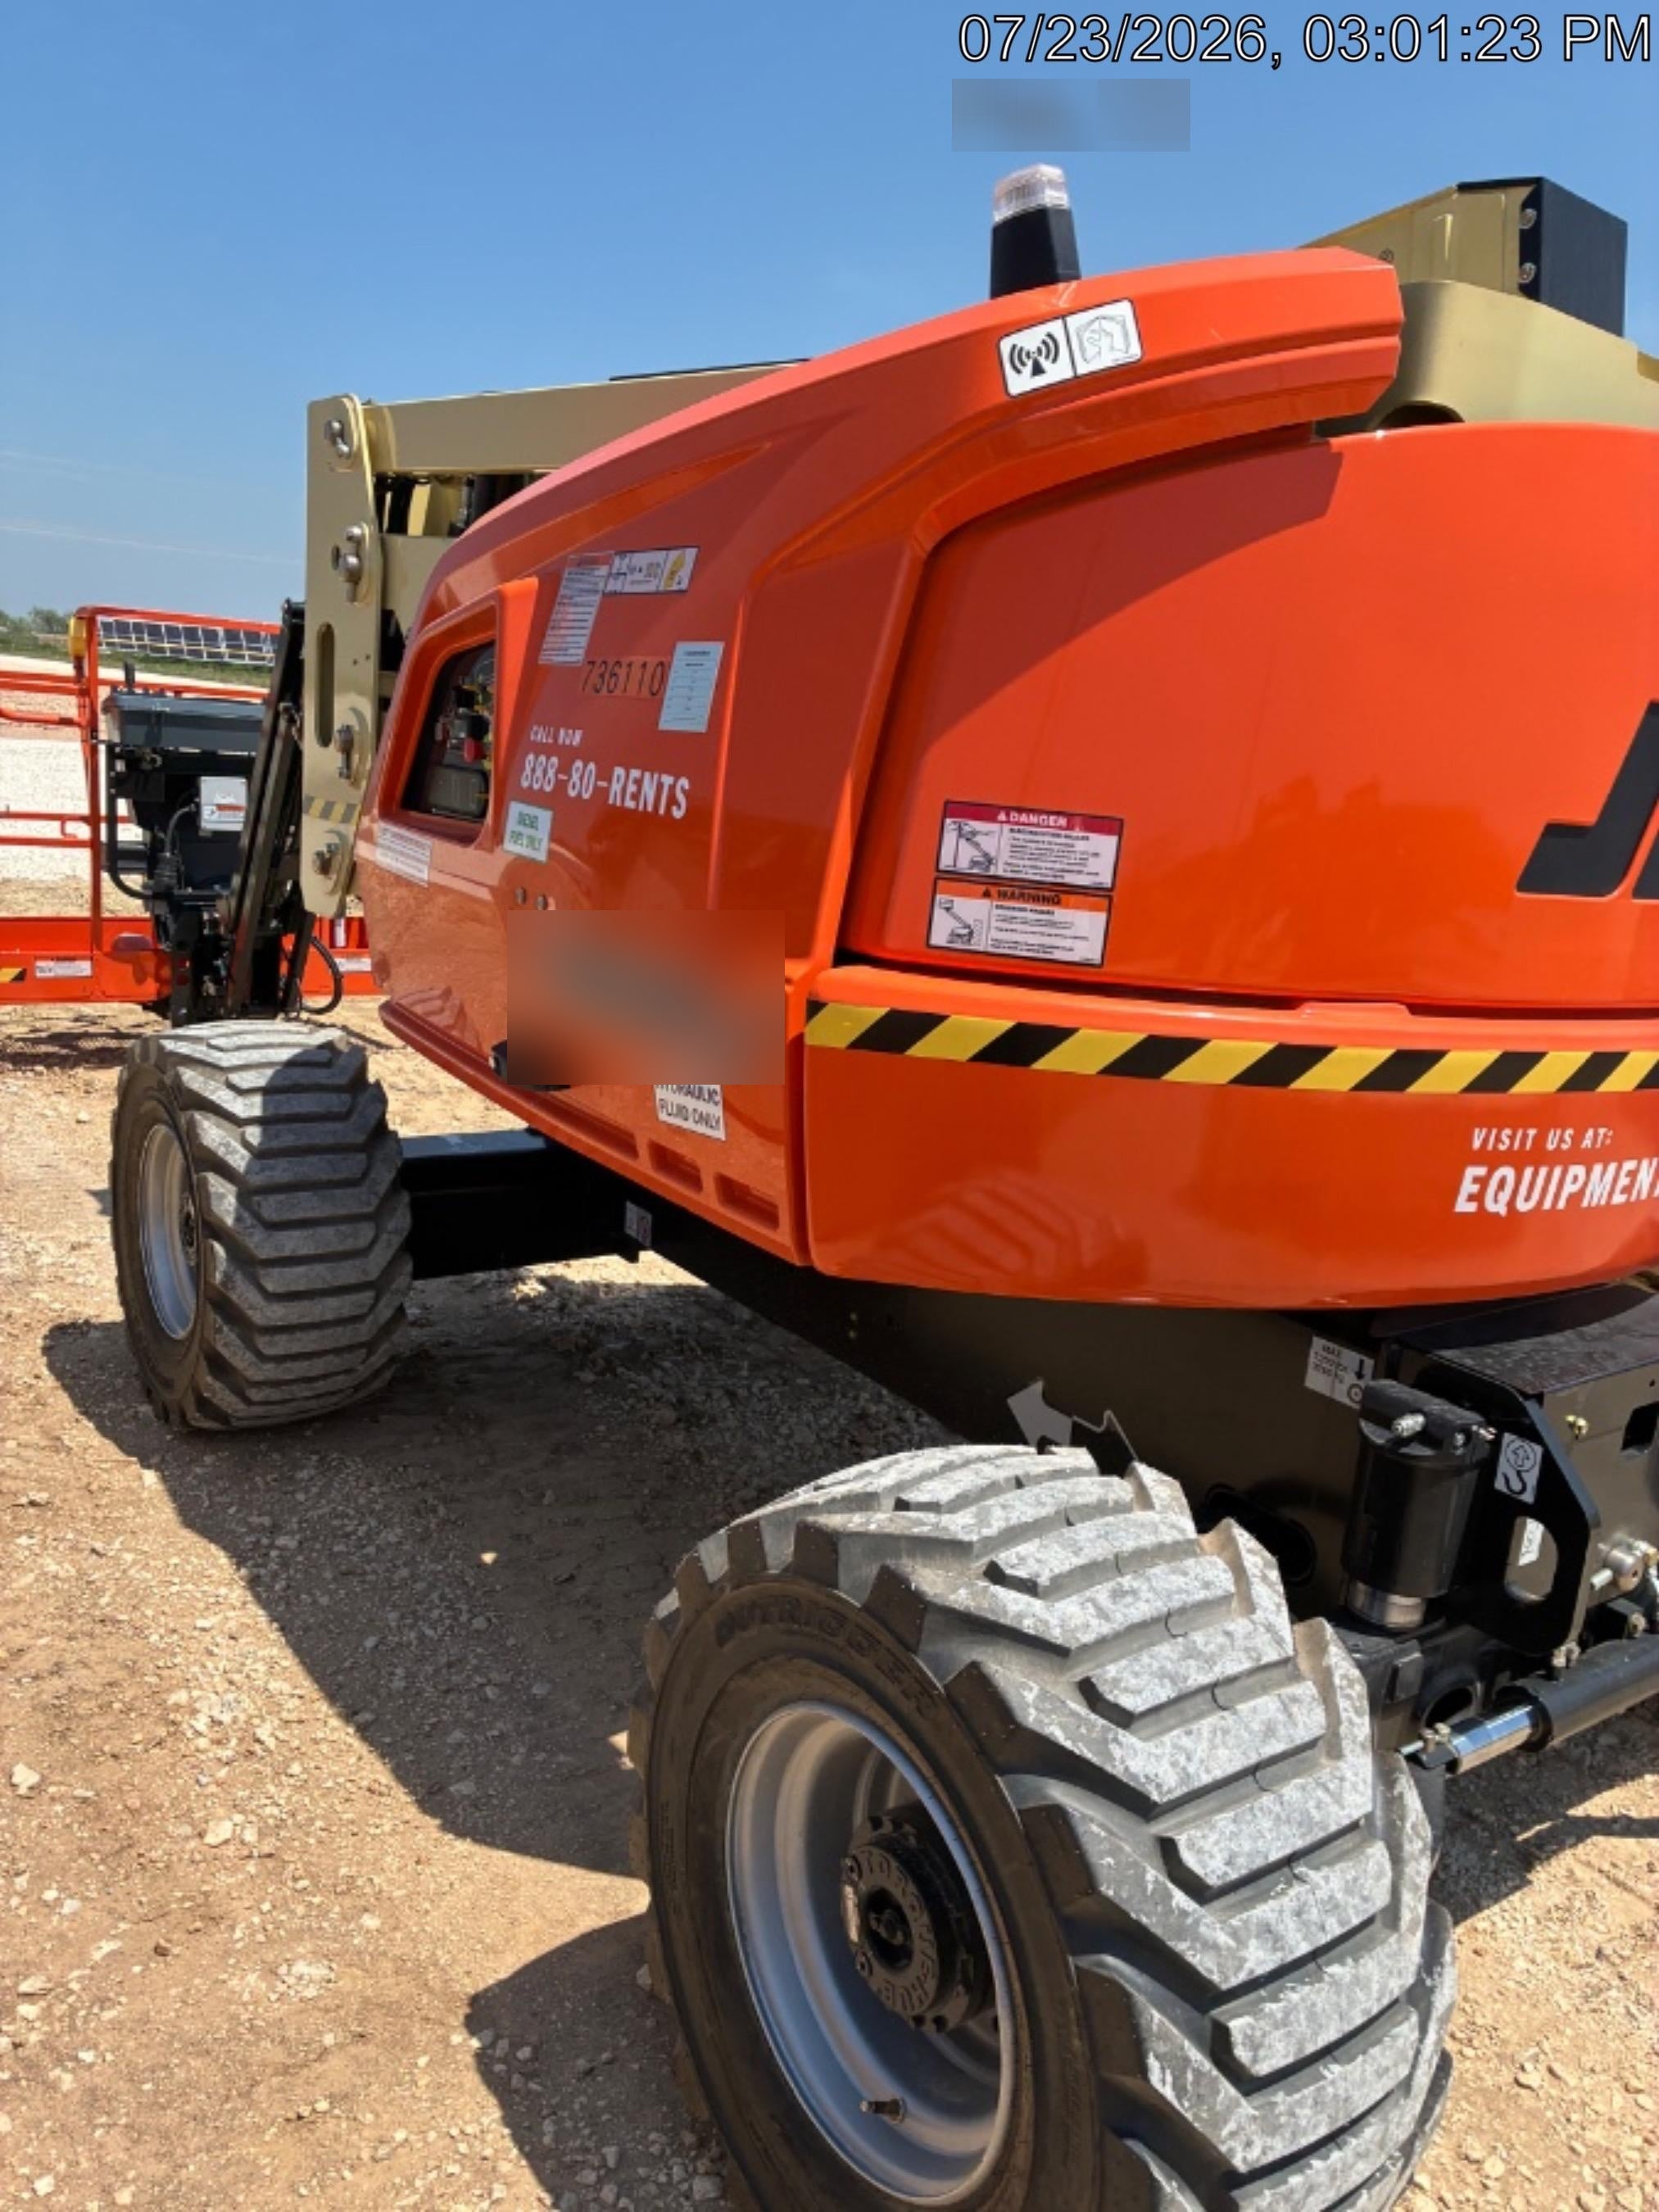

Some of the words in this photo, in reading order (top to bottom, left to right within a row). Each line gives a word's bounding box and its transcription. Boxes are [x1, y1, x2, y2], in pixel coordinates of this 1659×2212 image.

[582, 660, 664, 696] 736110
[530, 725, 554, 744] CALL
[558, 728, 583, 746] NOW
[520, 753, 690, 819] 888-80-RENTS
[1516, 700, 1659, 899] J
[1009, 809, 1067, 827] DANGER
[997, 888, 1062, 905] WARNING
[659, 1099, 688, 1122] FLUID
[692, 1108, 721, 1131] ONLY
[1472, 1127, 1537, 1150] VISIT
[1547, 1127, 1574, 1150] US
[1581, 1127, 1613, 1149] AT:
